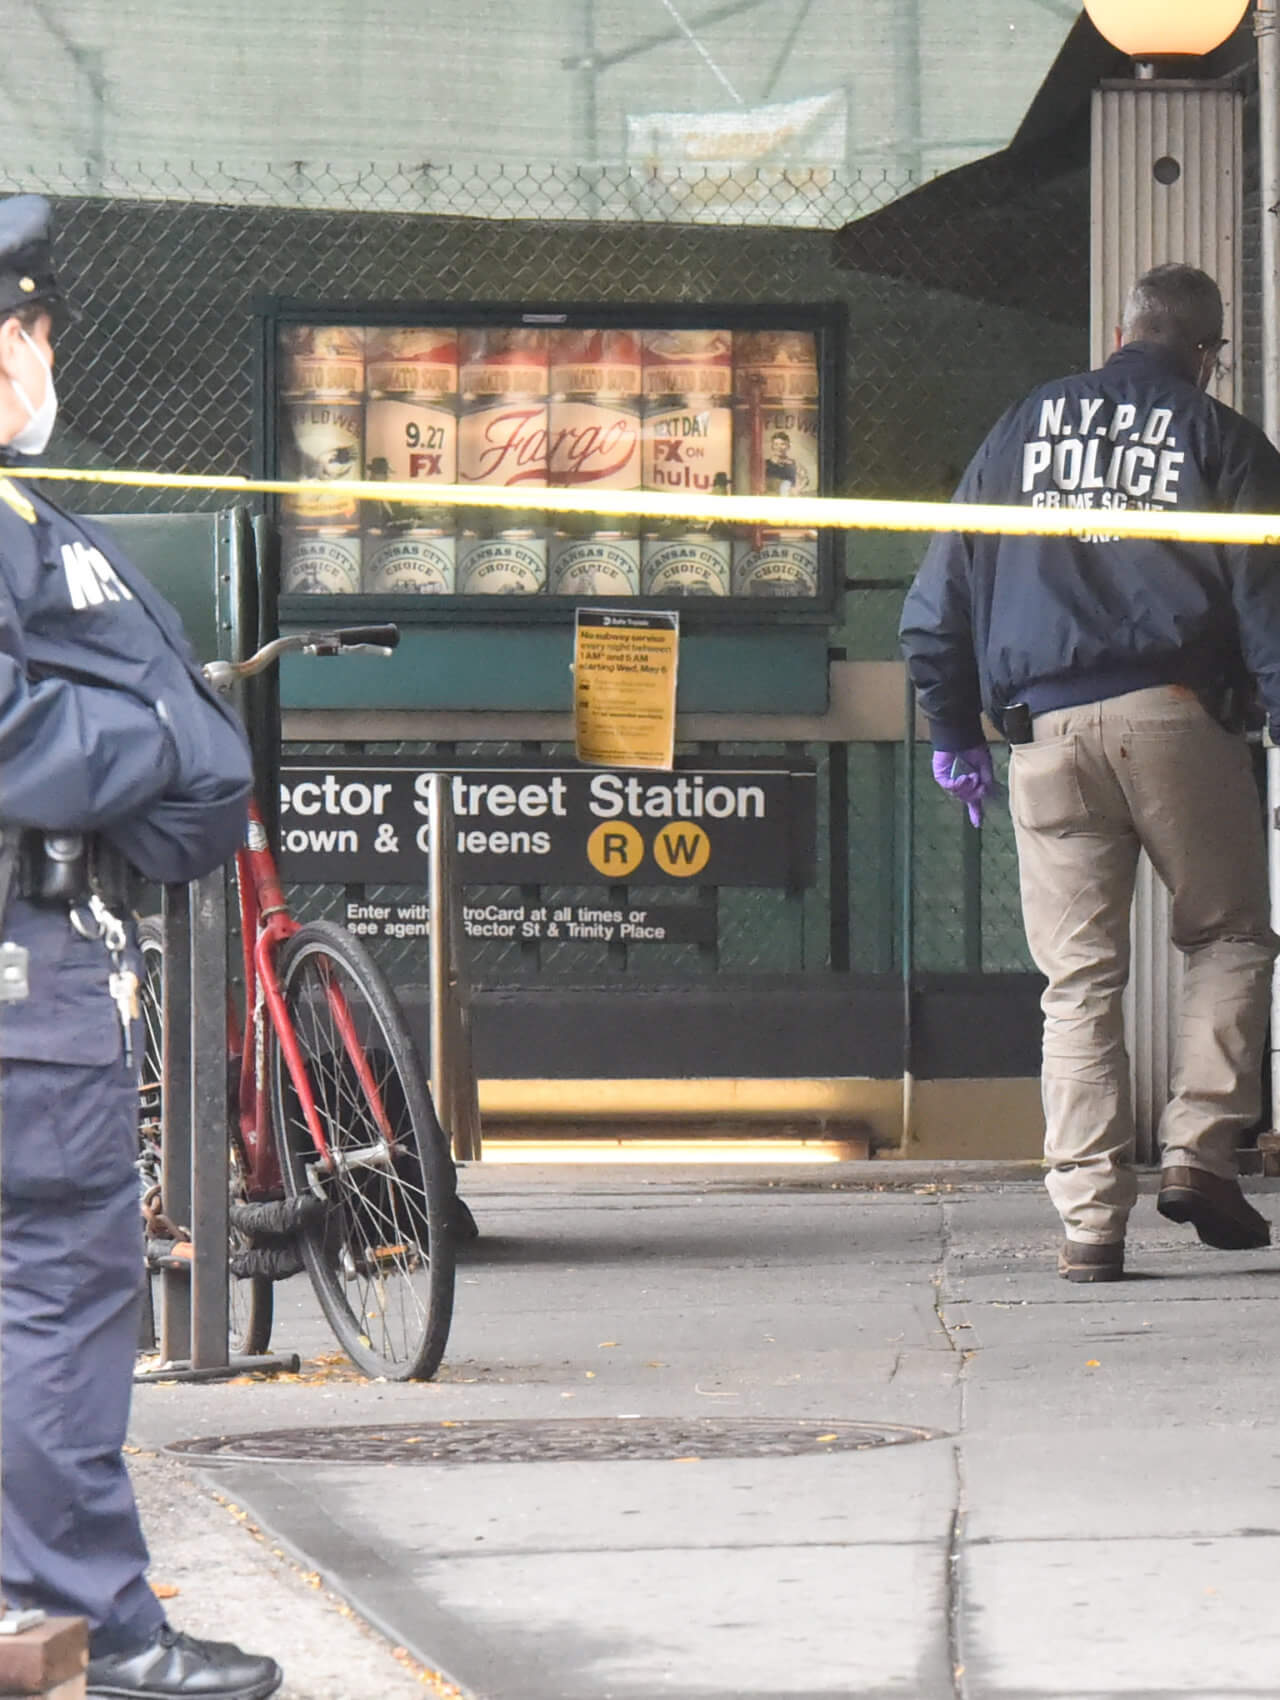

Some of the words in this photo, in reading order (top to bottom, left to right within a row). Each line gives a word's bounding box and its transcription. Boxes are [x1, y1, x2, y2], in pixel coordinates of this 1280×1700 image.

[682, 415, 710, 437] DAY
[1038, 397, 1176, 447] N.Y.P.D.
[405, 421, 445, 450] 9.27
[460, 409, 636, 485] Fargo
[654, 440, 685, 463] FX
[686, 446, 704, 458] ON
[409, 453, 442, 477] FX
[1022, 438, 1185, 503] POLICE
[653, 466, 710, 490] hulu
[385, 560, 435, 577] CHOICE
[478, 561, 527, 578] CHOICE
[607, 550, 635, 575] CITY
[663, 564, 711, 580] CHOICE
[699, 550, 728, 576] CITY
[280, 775, 392, 816] ctor
[413, 773, 568, 817] Street
[589, 774, 766, 818] Station
[281, 828, 359, 853] own
[374, 823, 400, 853] &
[602, 833, 629, 864] R
[662, 834, 700, 865] W
[347, 904, 392, 920] Enter
[397, 904, 431, 920] with
[463, 906, 525, 921] troCard
[530, 907, 547, 922] at
[553, 907, 572, 922] all
[578, 907, 623, 923] times
[629, 910, 647, 923] or
[348, 923, 378, 935] see
[384, 922, 431, 938] agent
[465, 921, 516, 937] Rector
[522, 922, 541, 937] St
[546, 922, 560, 938] &
[567, 923, 614, 941] Trinity
[620, 924, 666, 939] Place
